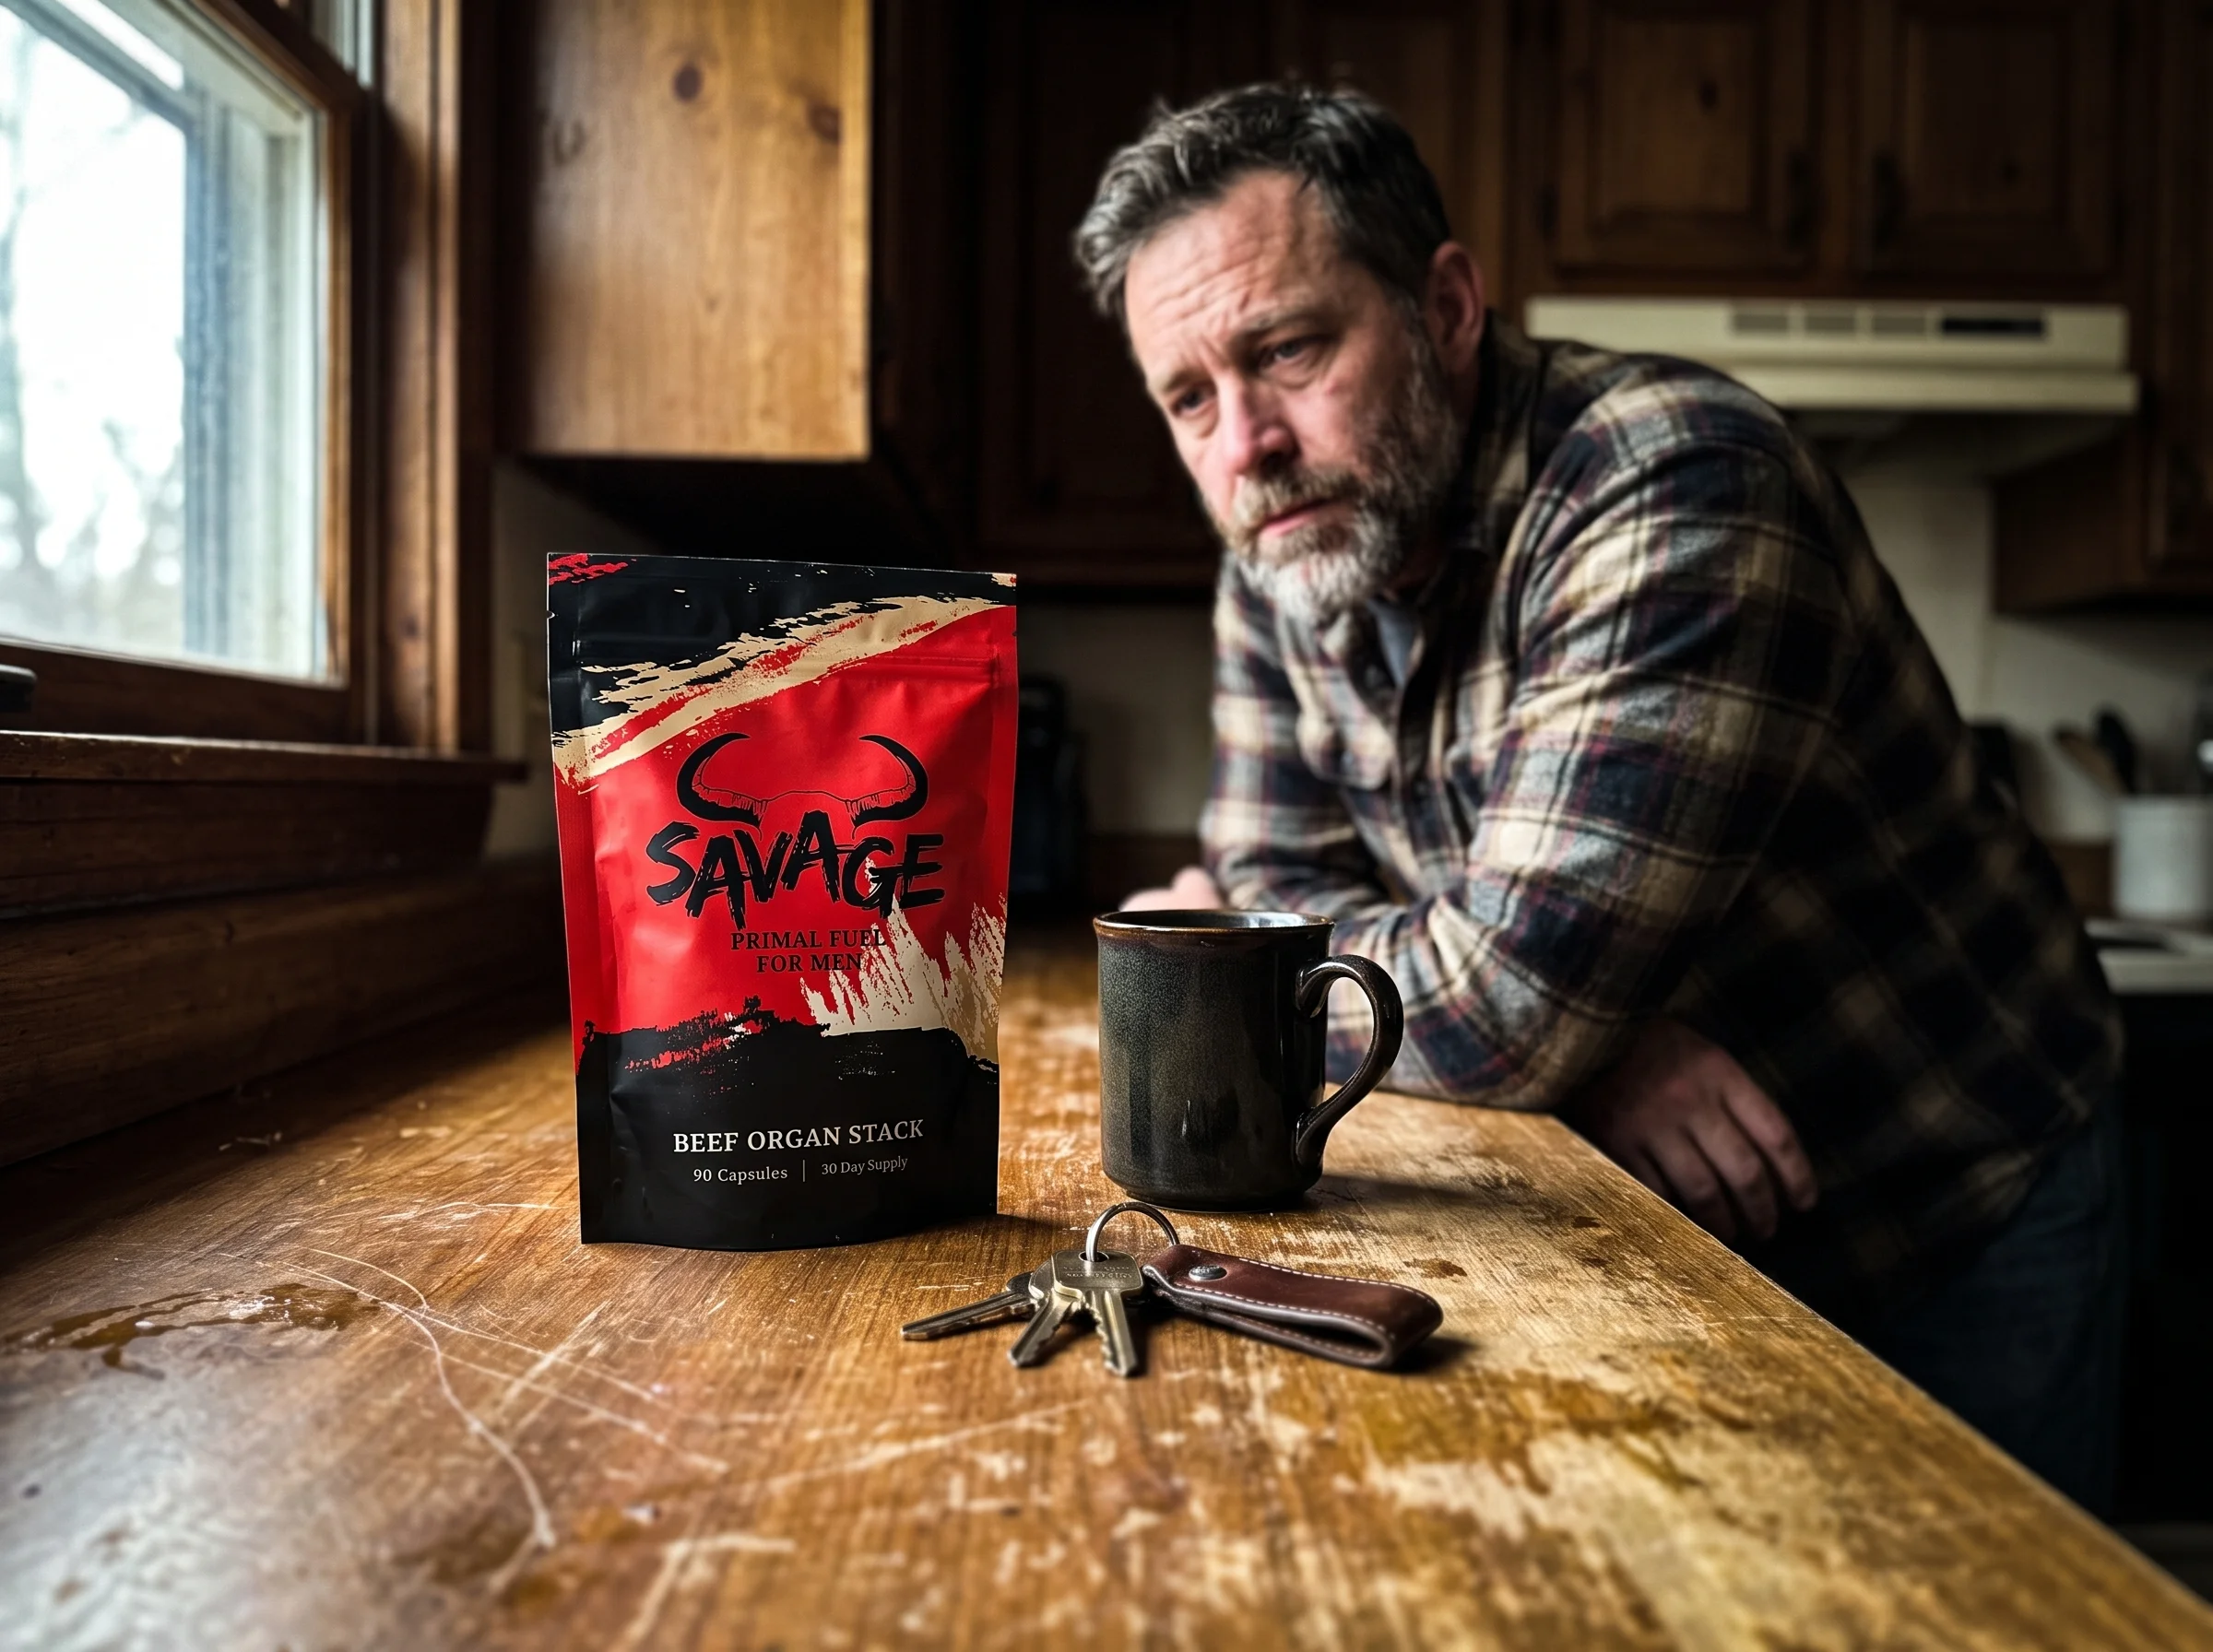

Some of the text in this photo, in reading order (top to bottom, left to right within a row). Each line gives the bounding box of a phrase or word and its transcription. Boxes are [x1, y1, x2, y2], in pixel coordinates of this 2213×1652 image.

[645, 809, 946, 932] SAVAGE
[730, 928, 887, 950] PRIMAL FUEL
[756, 952, 863, 973] FOR MEN
[673, 1118, 924, 1152] BEEF ORGAN STACK
[692, 1155, 908, 1185] 90 Capsules 30 Day Supply
